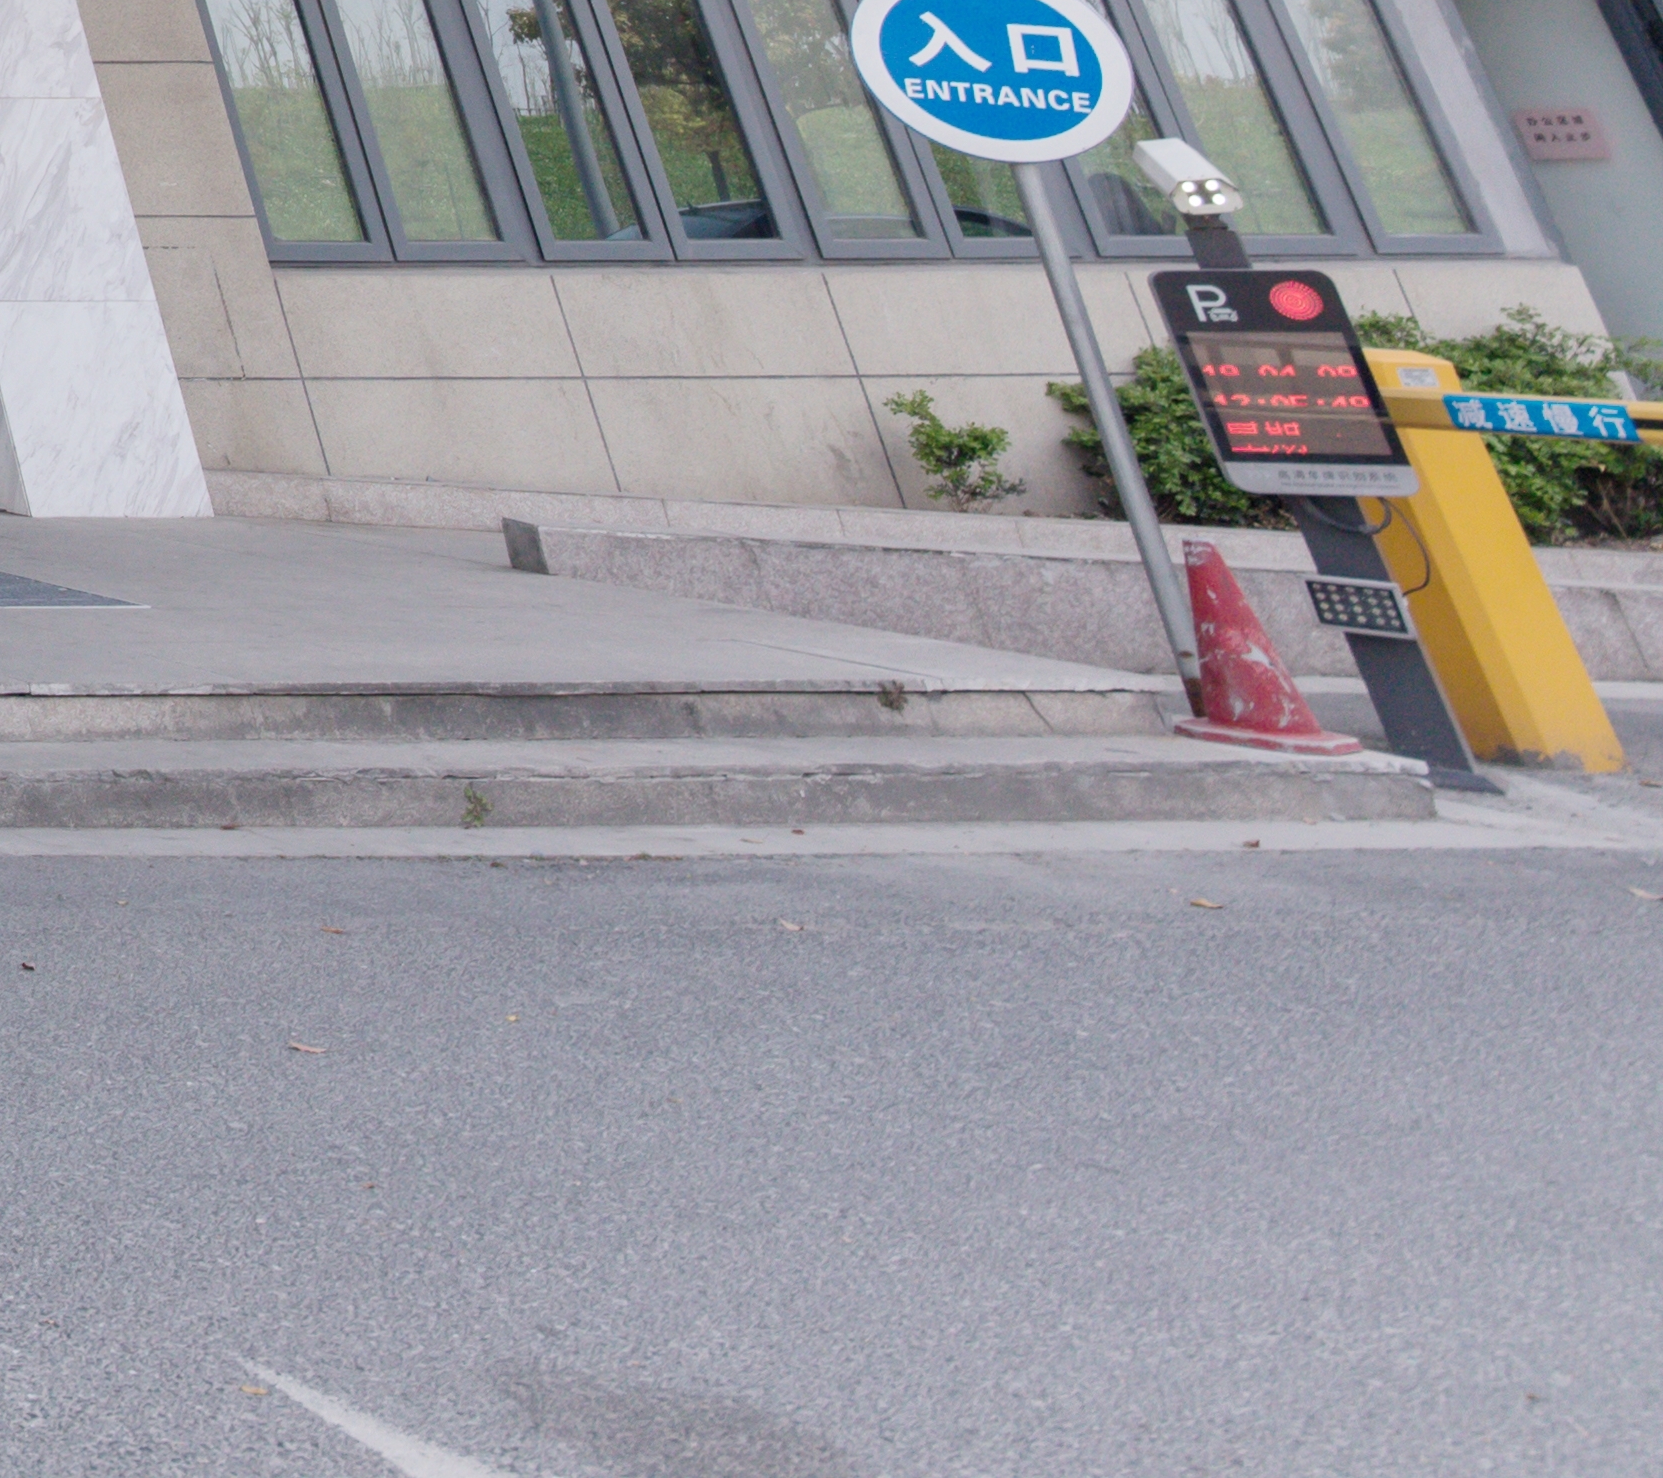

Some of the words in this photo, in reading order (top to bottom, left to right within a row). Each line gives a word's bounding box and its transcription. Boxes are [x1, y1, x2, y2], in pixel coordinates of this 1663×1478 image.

[908, 10, 1081, 78] 入口
[903, 77, 1092, 114] ENTRANCE
[1452, 399, 1627, 439] 减速慢行
